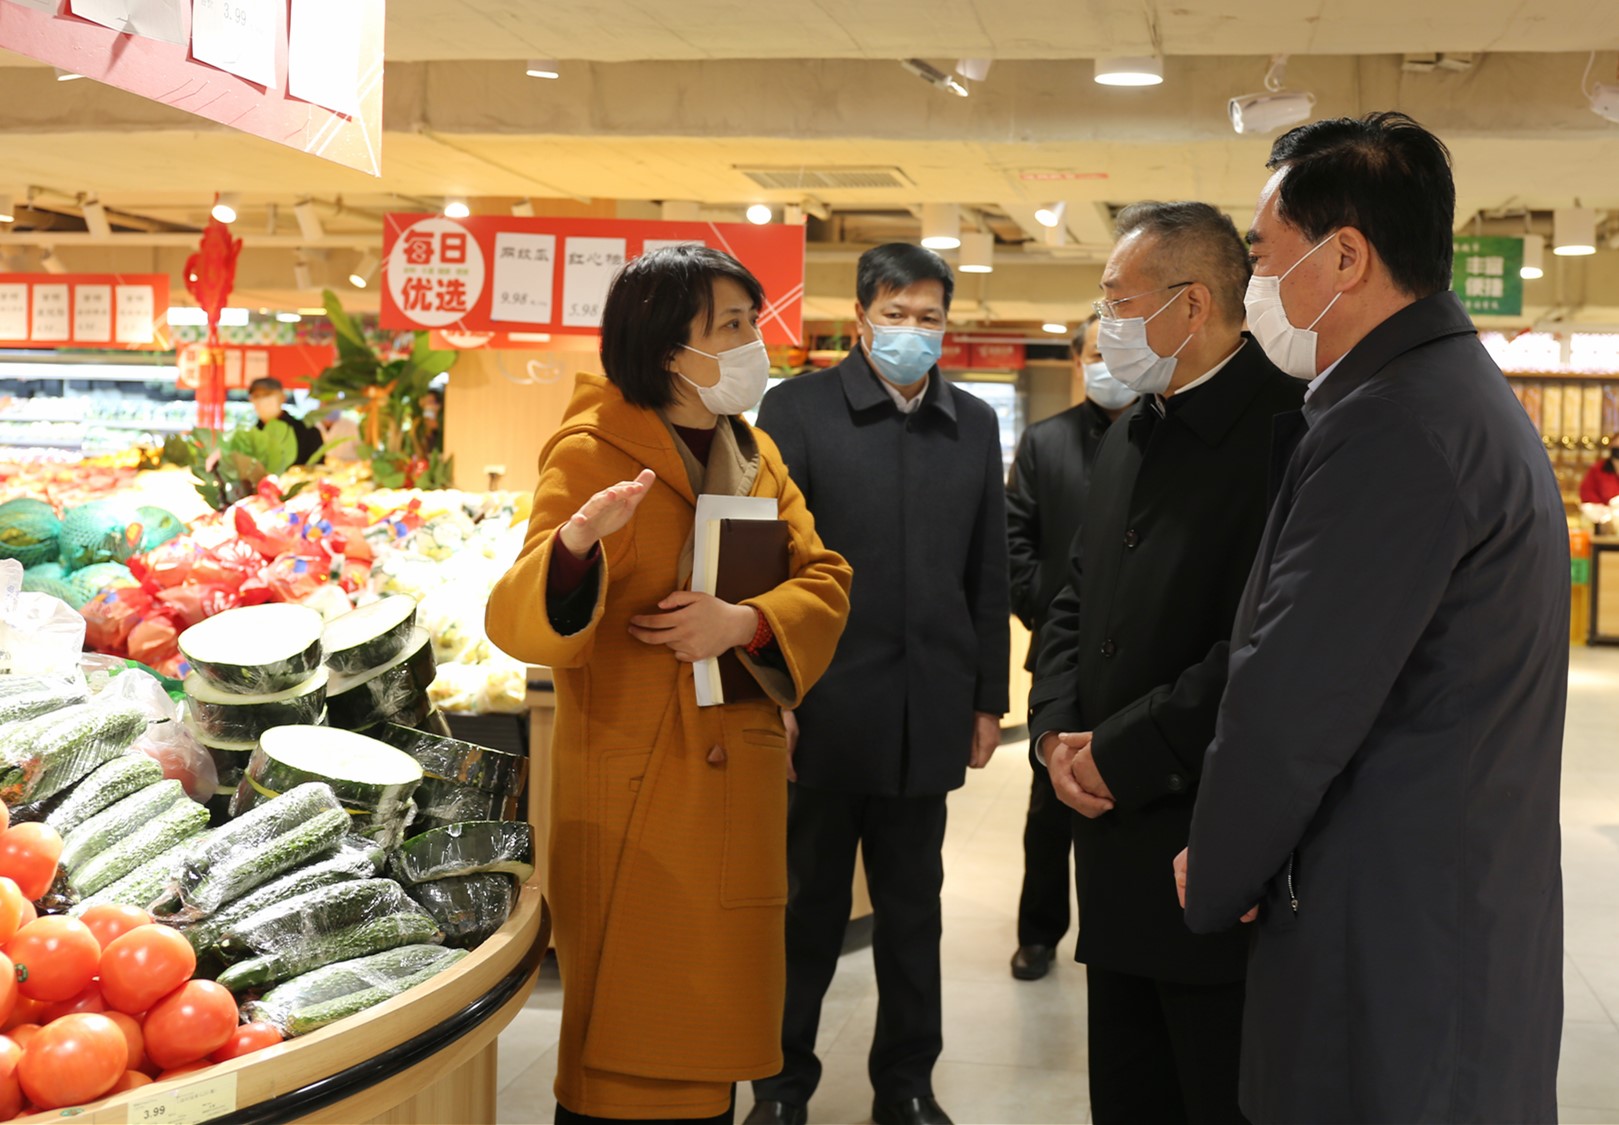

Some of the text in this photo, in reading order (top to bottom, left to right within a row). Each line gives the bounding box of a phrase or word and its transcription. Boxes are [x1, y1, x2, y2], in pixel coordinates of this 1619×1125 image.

[223, 2, 247, 26] 3.99
[402, 229, 467, 264] 每日
[401, 277, 467, 312] 优选
[500, 291, 528, 305] 9.98
[143, 1105, 166, 1120] 3.99
